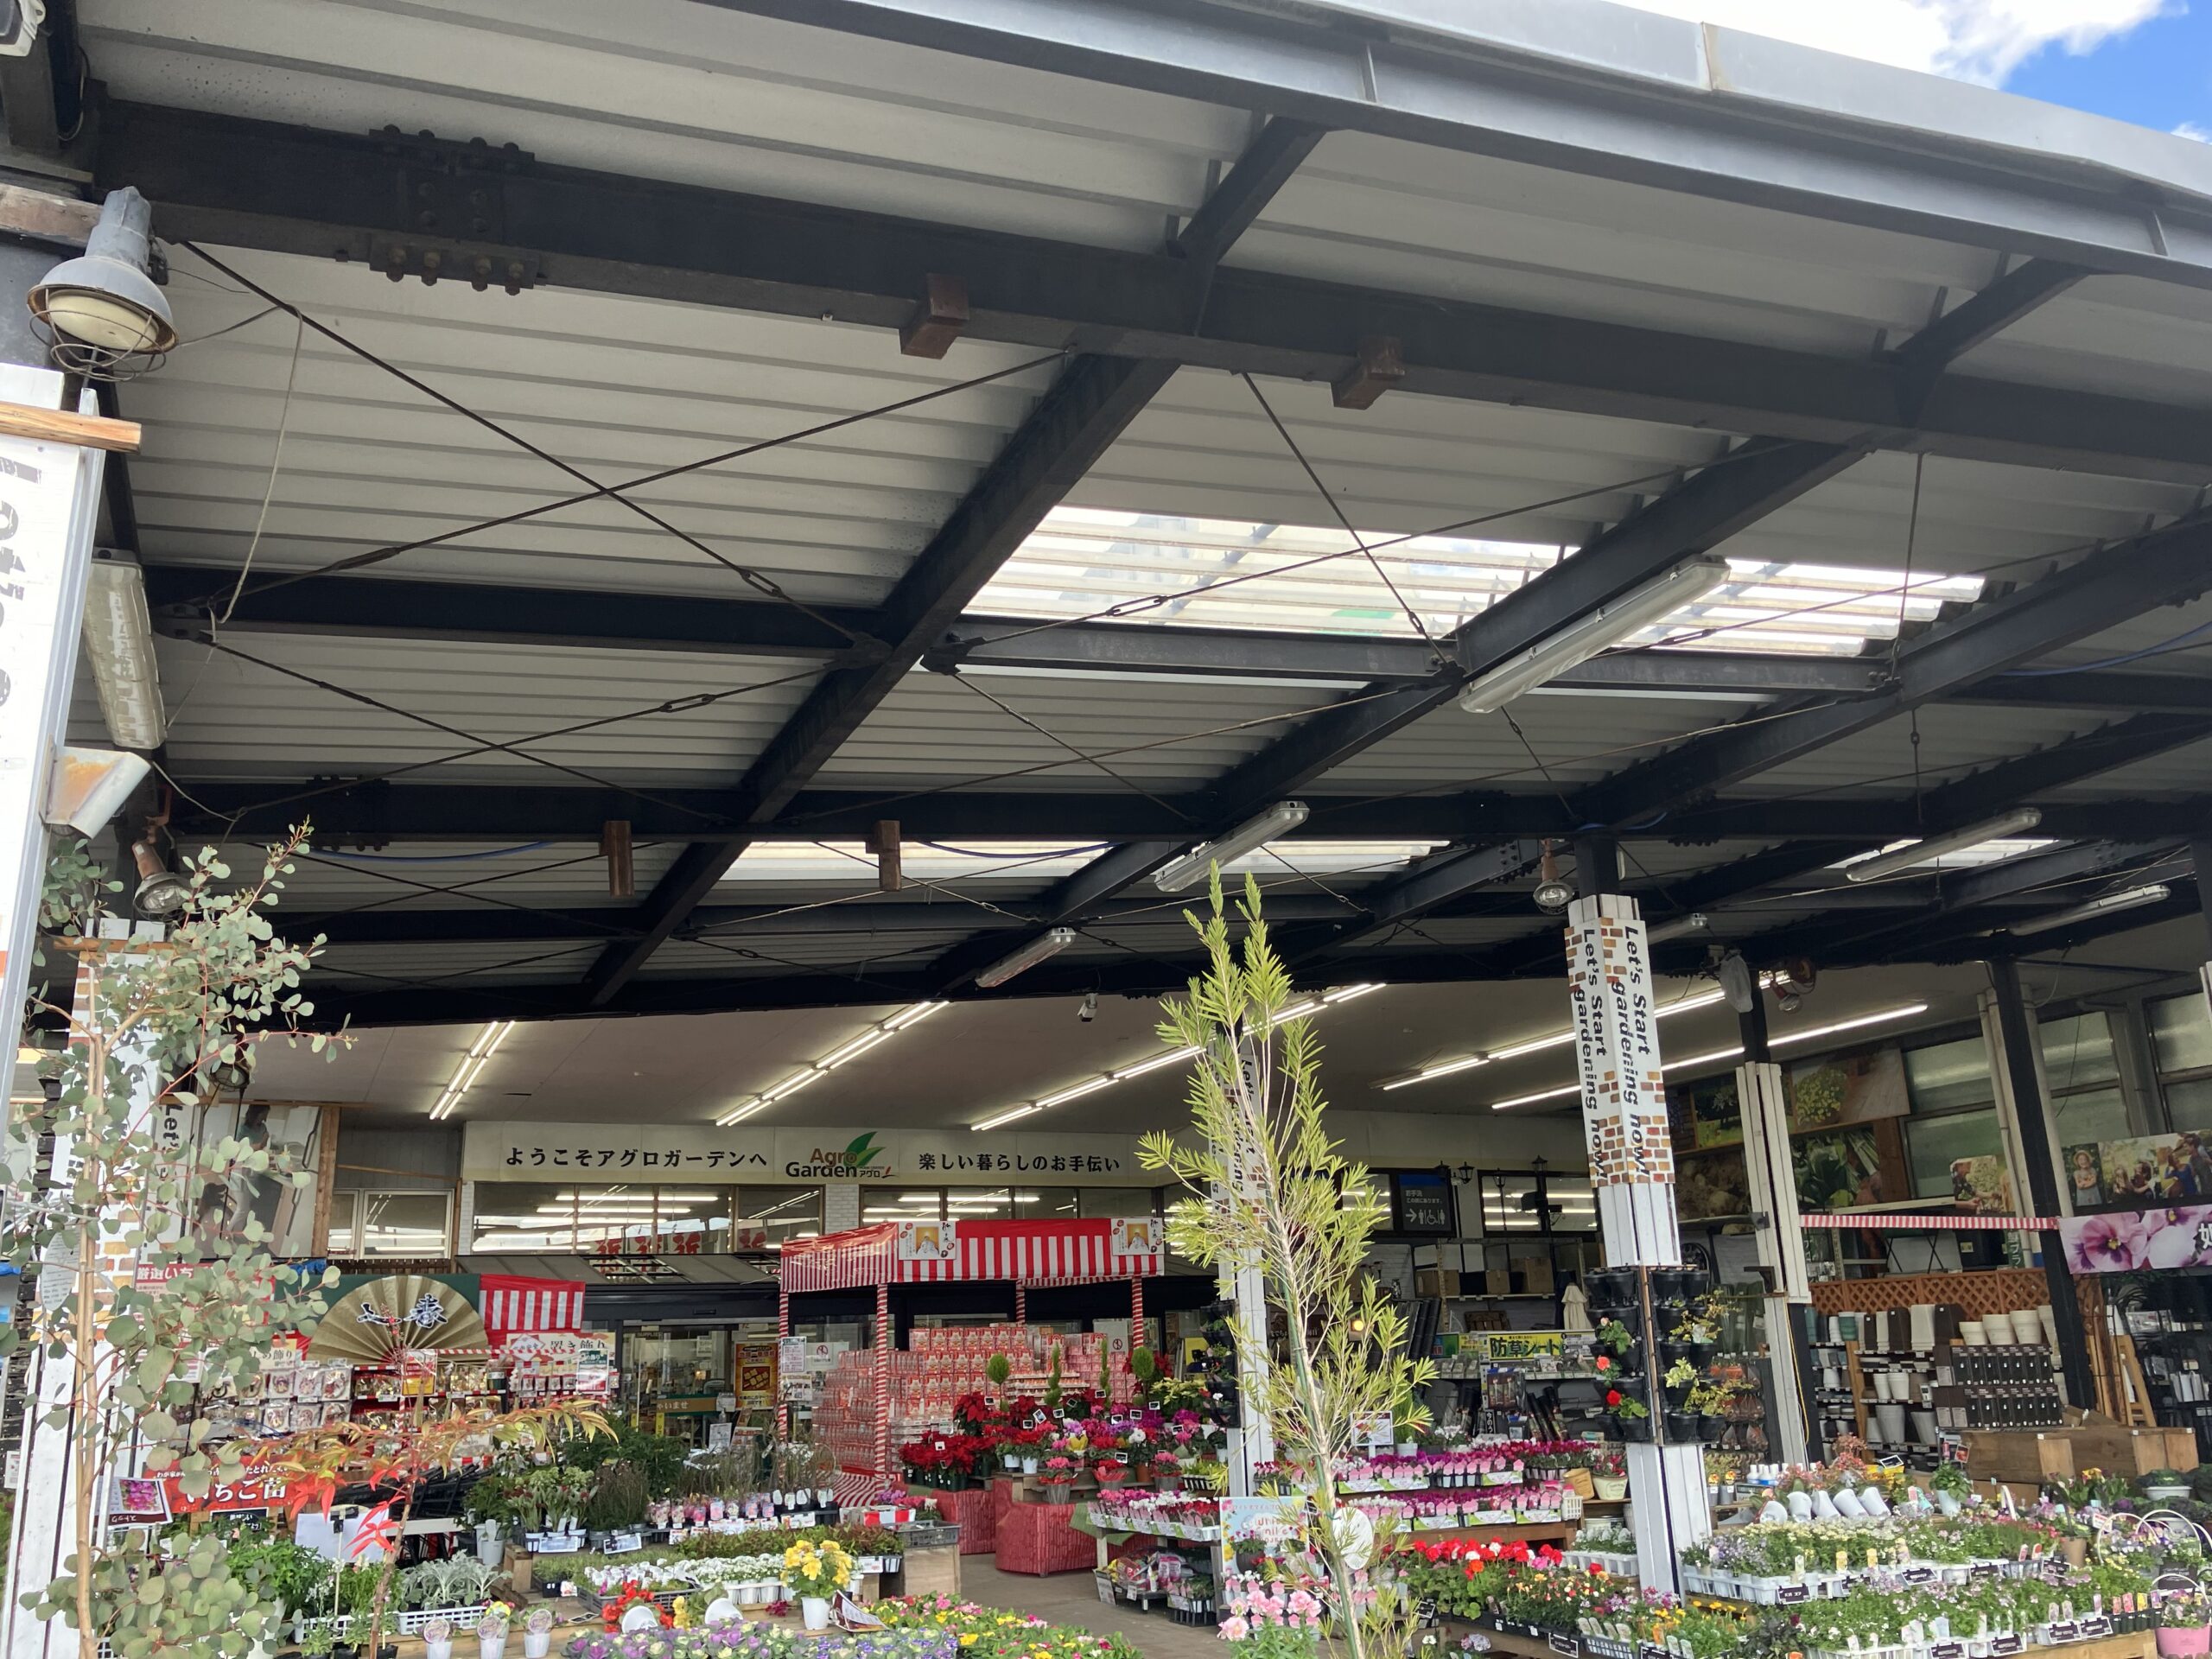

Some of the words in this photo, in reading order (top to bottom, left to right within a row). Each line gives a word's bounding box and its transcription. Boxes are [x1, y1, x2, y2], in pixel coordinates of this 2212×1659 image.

[1584, 929, 1599, 986] Let's
[1625, 925, 1642, 985] Let's
[1591, 995, 1607, 1056] Start
[1611, 981, 1638, 1106] gardening
[1633, 994, 1652, 1055] Start
[1574, 989, 1598, 1109] gardening
[506, 1147, 767, 1167] ようこそアグロガーデンへ
[785, 1161, 858, 1178] Garden
[810, 1147, 858, 1169] Agro
[918, 1153, 1121, 1173] 楽しい暮らしのお手伝い
[1490, 1338, 1560, 1357] 防草シート
[111, 1515, 137, 1523] ストック
